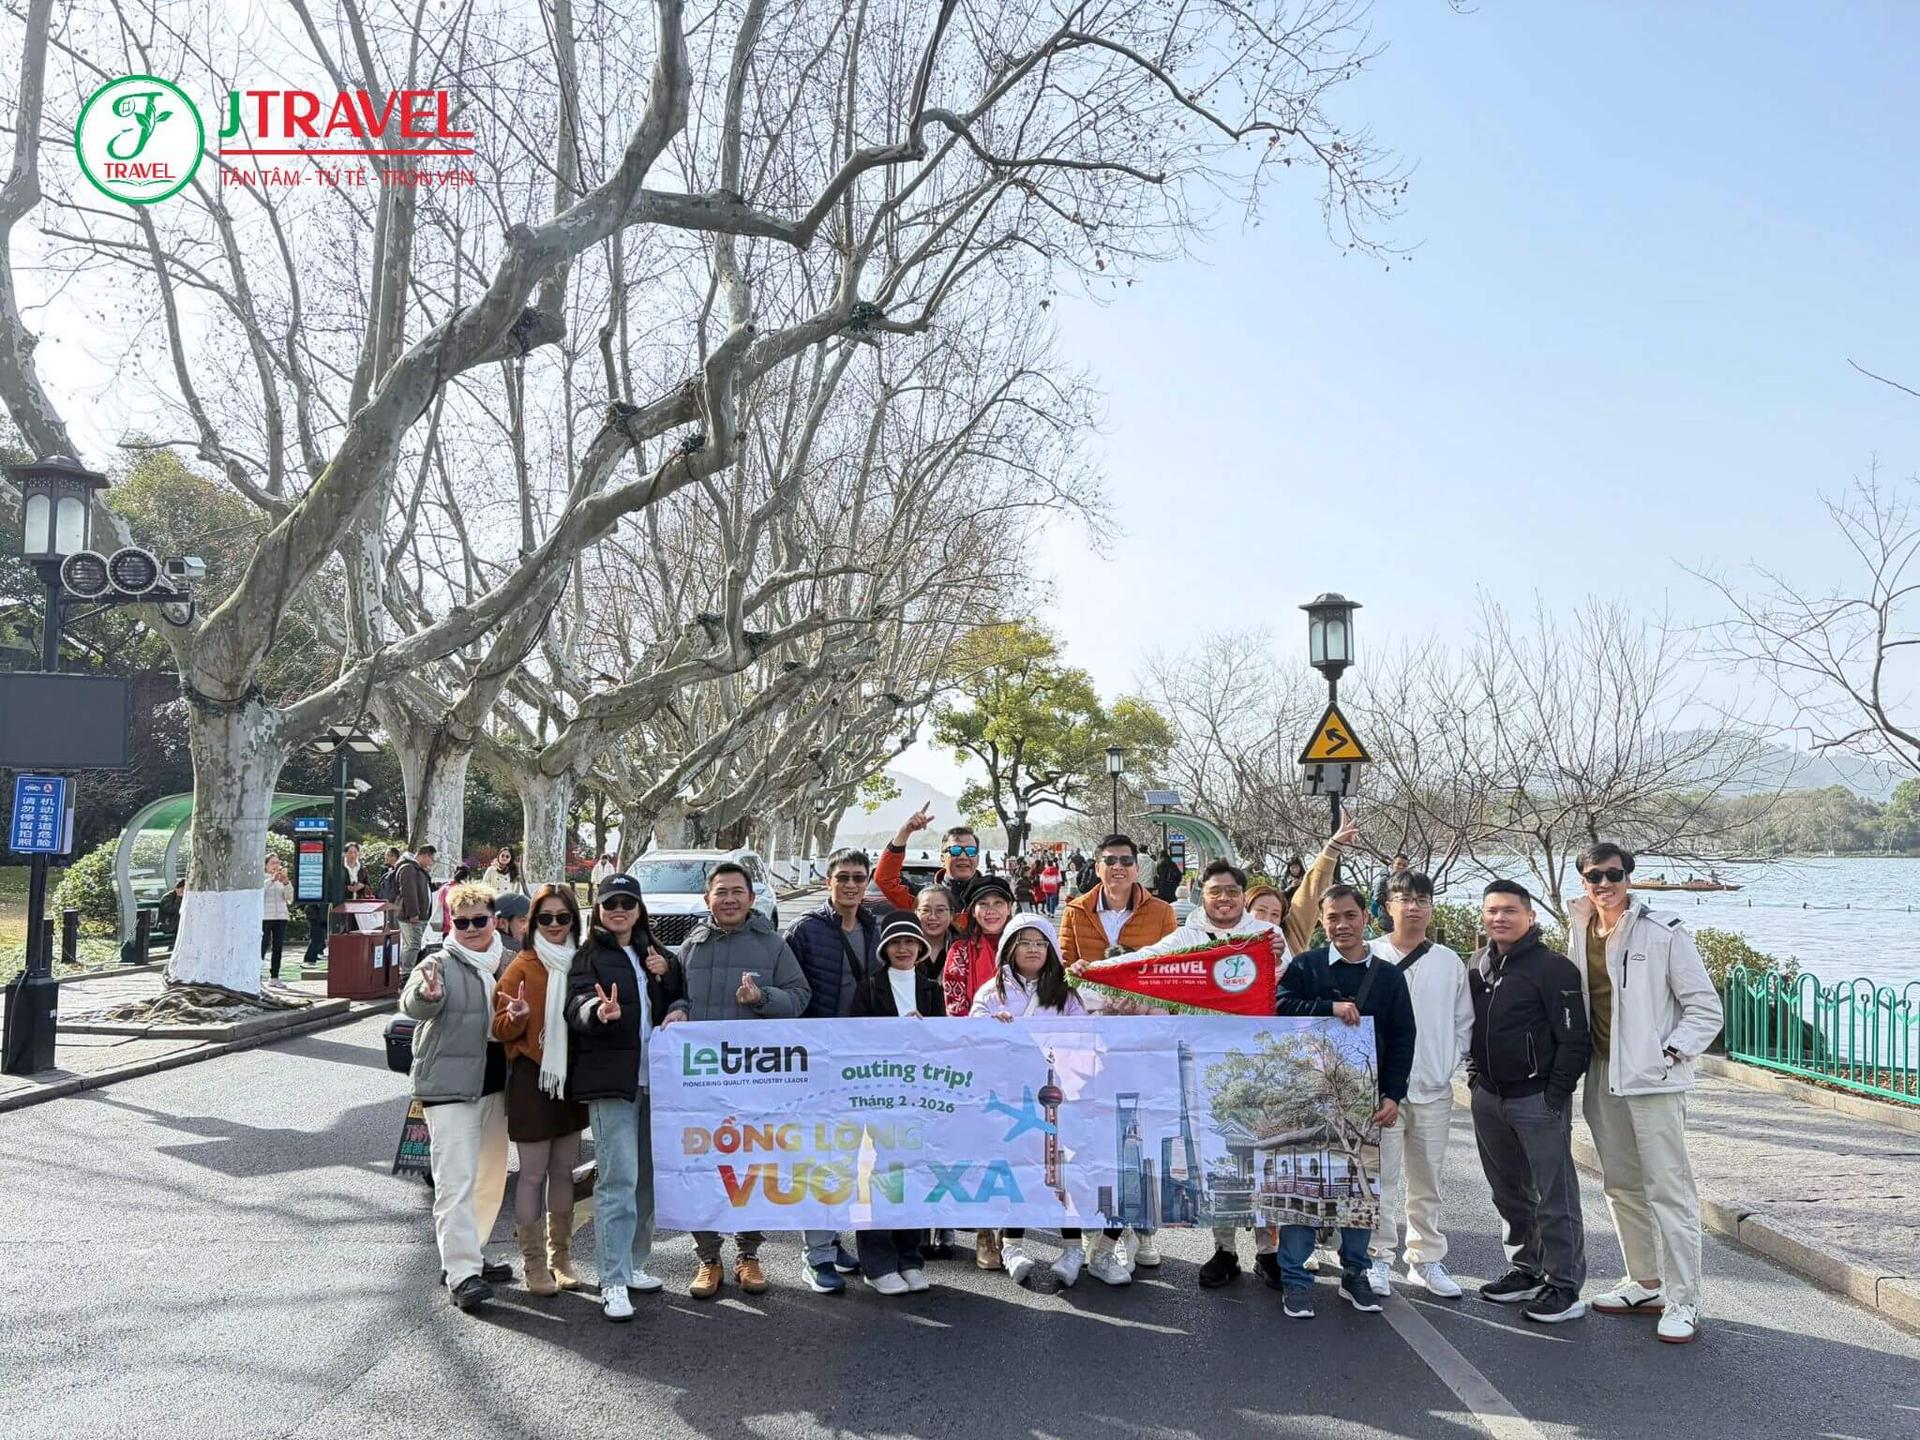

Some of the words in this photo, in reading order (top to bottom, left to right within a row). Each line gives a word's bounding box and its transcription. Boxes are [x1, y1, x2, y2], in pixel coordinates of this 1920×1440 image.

[18, 797, 35, 846] 请勿停留拍照
[37, 798, 55, 847] 机动车道危险
[1152, 960, 1207, 974] TRAVEL
[683, 1041, 808, 1076] Letran
[841, 1060, 917, 1083] outing
[922, 1063, 973, 1089] trip!
[682, 1080, 721, 1088] PIONEERING
[752, 1077, 783, 1086] INDUSTRY
[849, 1095, 895, 1109] Tháng
[898, 1095, 907, 1106] 2
[918, 1097, 955, 1113] 2026
[924, 1160, 1025, 1203] XA
